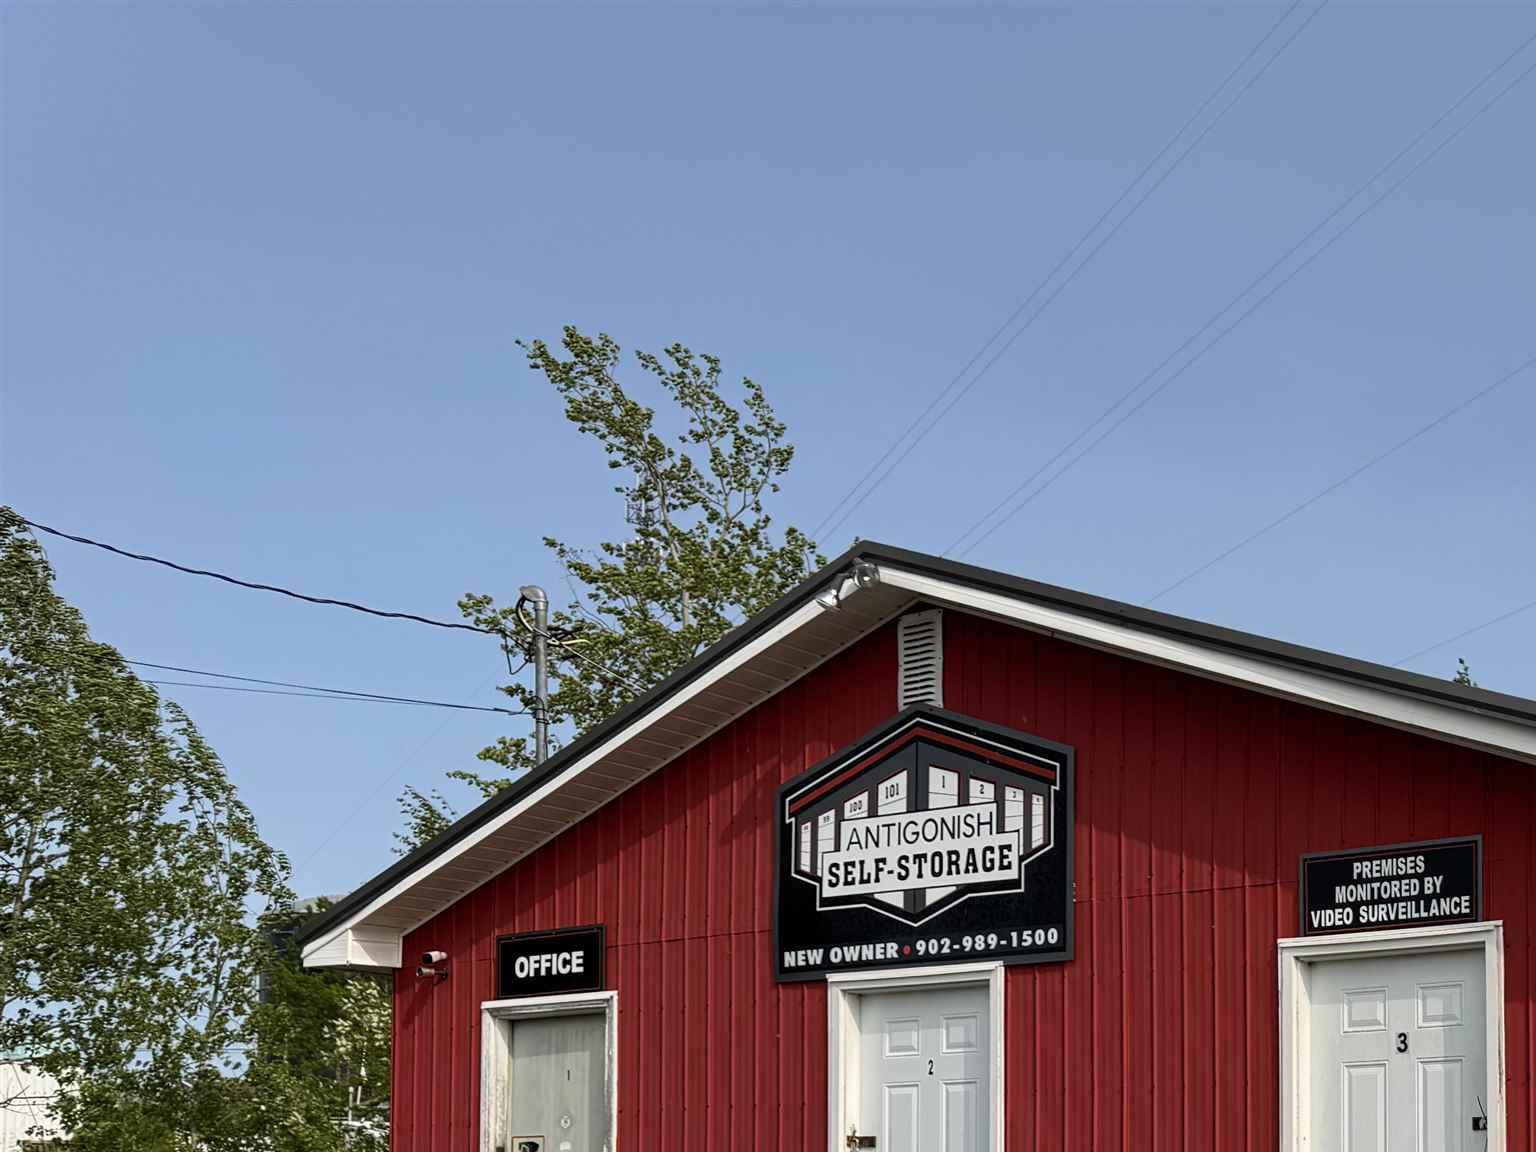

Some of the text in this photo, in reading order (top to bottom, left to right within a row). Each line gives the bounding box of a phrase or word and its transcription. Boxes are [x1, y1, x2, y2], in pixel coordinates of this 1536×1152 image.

[884, 782, 900, 799] 101
[979, 784, 985, 794] 2
[846, 810, 993, 851] ANTIGONISH
[827, 843, 1013, 888] SELF-STORAGE
[1353, 855, 1425, 880] PREMISES
[1335, 875, 1444, 904] MONITORED BY
[1311, 895, 1470, 928] VIDEO SURVEILLANCE
[784, 927, 1059, 968] NEW OWNER 902-989-1500
[514, 951, 585, 978] OFFICE
[1396, 1032, 1409, 1053] 3
[928, 1059, 934, 1076] 2
